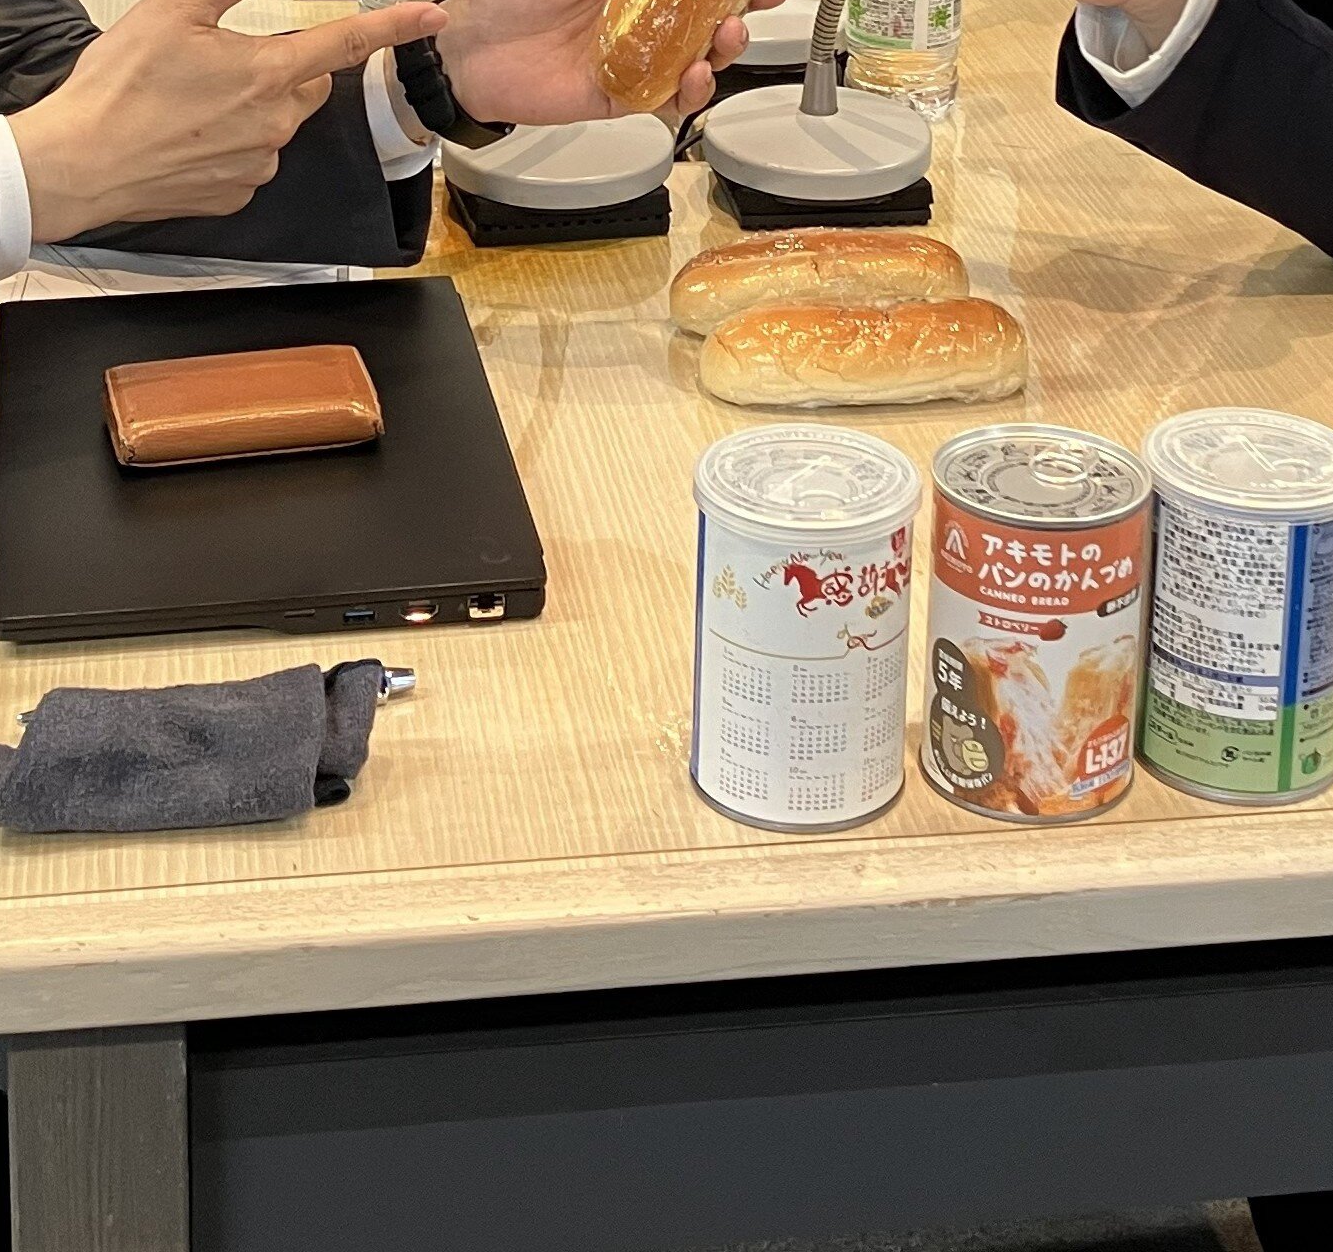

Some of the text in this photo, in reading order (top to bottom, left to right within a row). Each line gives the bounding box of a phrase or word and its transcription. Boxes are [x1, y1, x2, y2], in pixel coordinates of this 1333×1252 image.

[981, 533, 1101, 567] アキモトの
[978, 556, 1133, 592] パンのかんづめ
[979, 585, 1070, 606] CANNED BREAD
[984, 617, 1040, 633] ストロベリー
[937, 659, 963, 691] 5年
